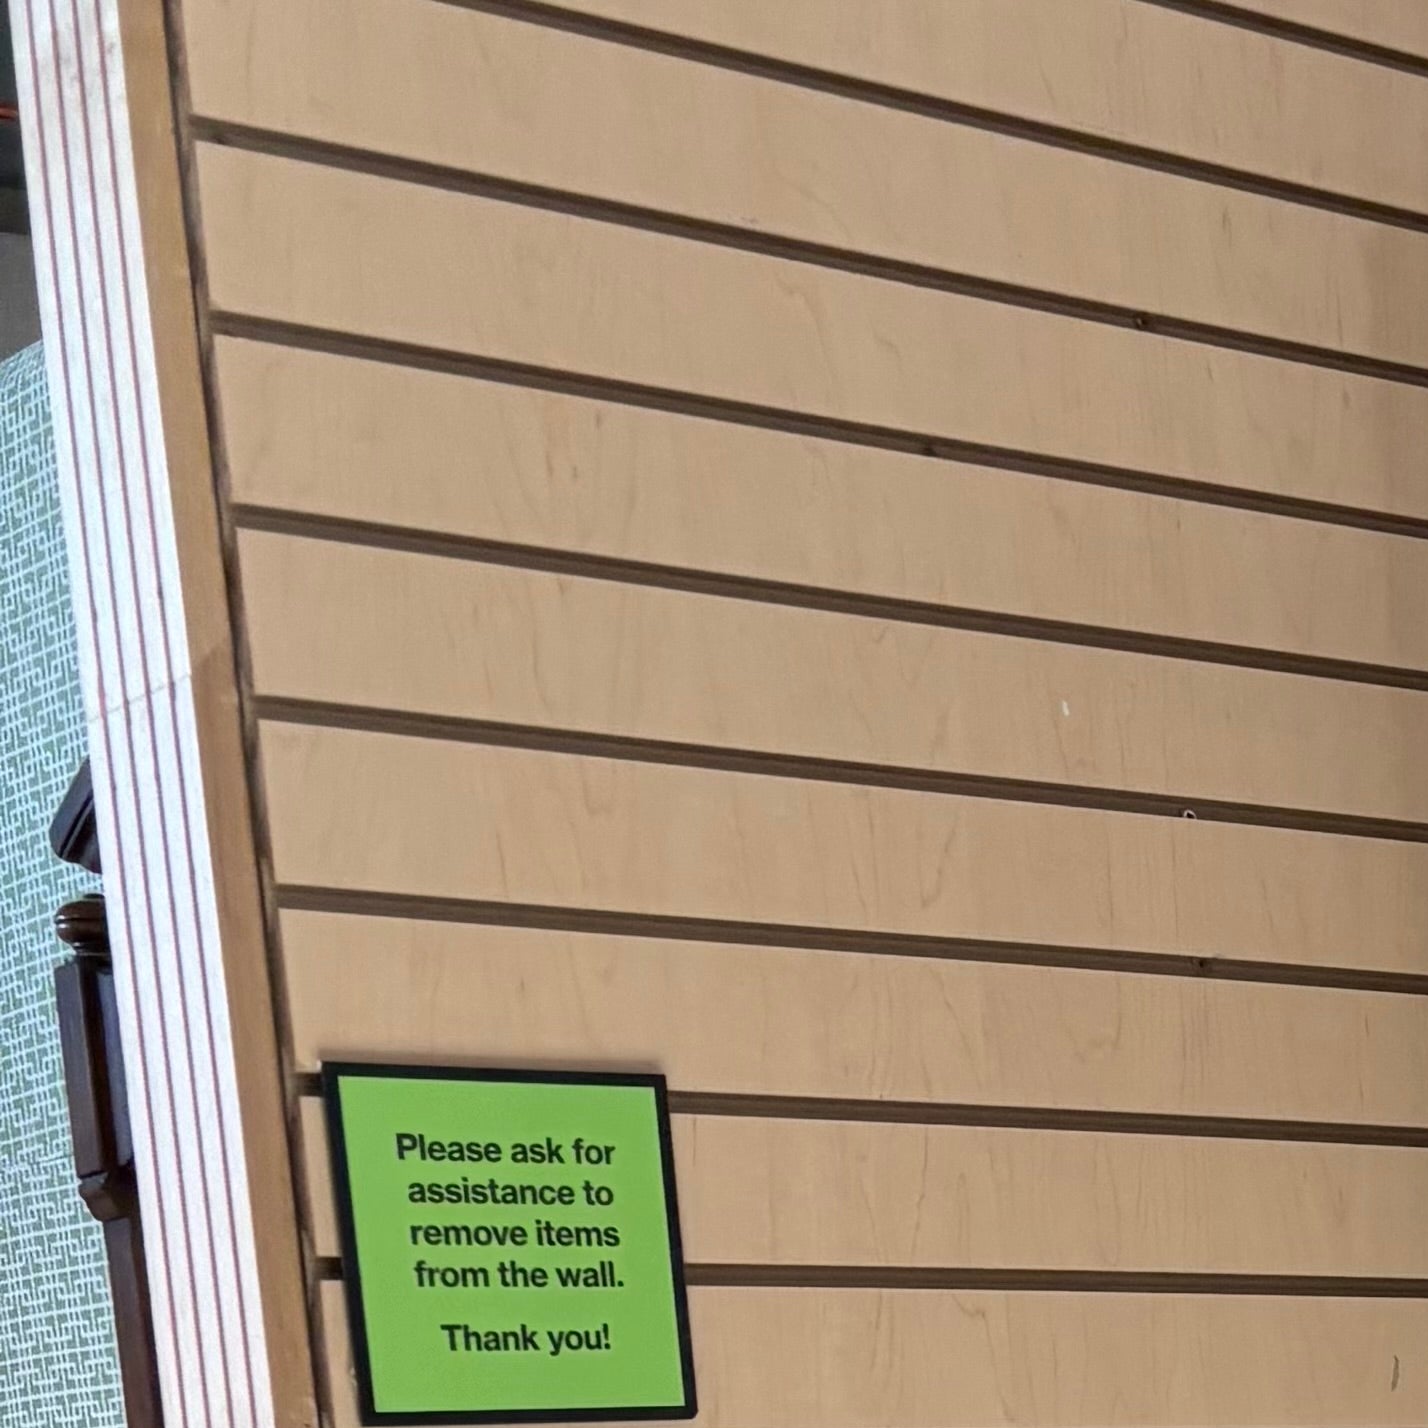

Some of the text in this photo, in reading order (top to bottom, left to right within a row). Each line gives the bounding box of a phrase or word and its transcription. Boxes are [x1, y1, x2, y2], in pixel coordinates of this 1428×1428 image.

[395, 1133, 616, 1165] Please ask for
[408, 1177, 614, 1206] assistance to
[410, 1220, 620, 1247] remove items
[414, 1260, 624, 1287] from the wall.
[440, 1323, 611, 1356] Thank you!
